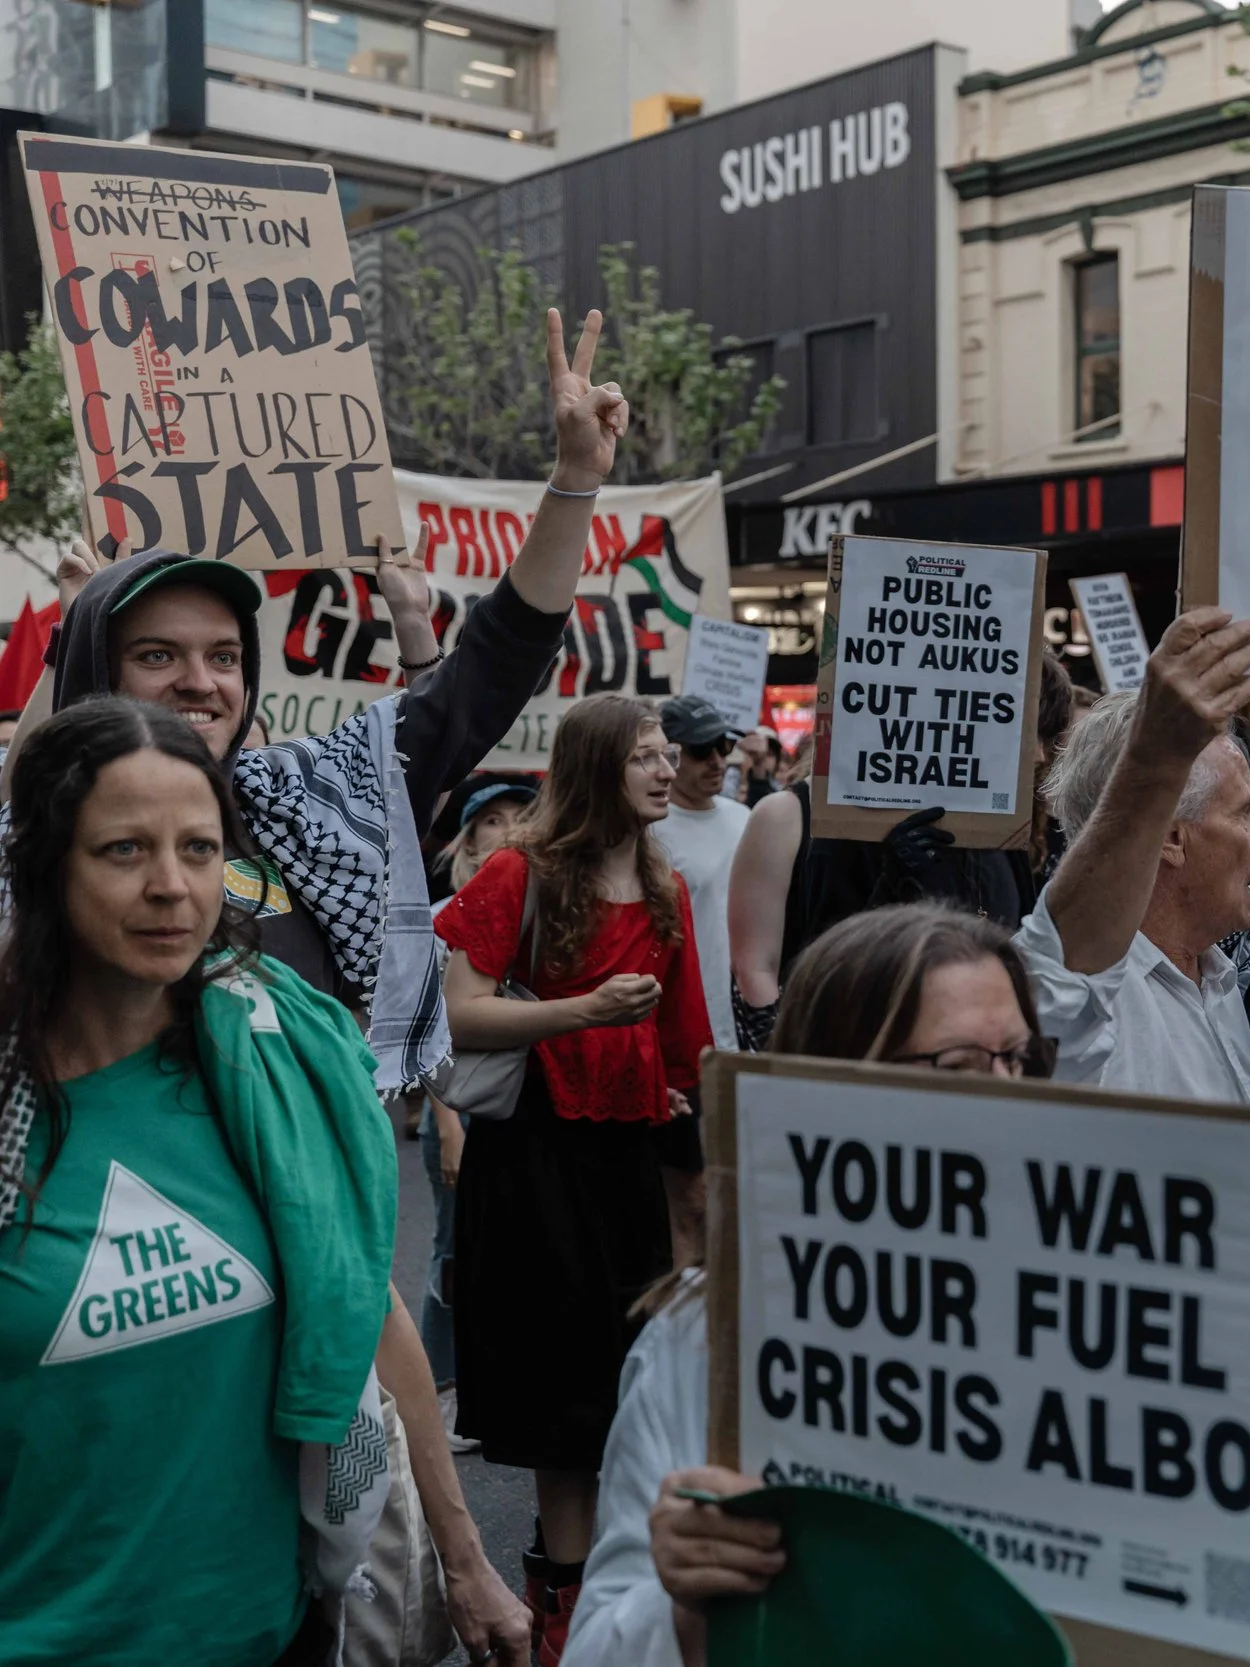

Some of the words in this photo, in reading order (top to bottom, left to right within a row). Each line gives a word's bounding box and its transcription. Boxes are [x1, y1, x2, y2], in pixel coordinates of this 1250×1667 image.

[720, 125, 823, 214] SUSHI
[829, 101, 911, 184] HUB
[50, 201, 312, 248] CONVENTION
[186, 250, 225, 274] OF
[54, 266, 367, 358] COWARDS
[176, 367, 200, 381] IN
[220, 368, 234, 383] A
[81, 390, 377, 460] CAPTURED
[93, 461, 406, 560] STATE
[778, 499, 872, 558] KFC
[917, 566, 957, 576] REDLINE
[918, 556, 967, 567] POLITICAL
[882, 576, 992, 610] PUBLIC
[867, 607, 1002, 643] HOUSING
[844, 637, 905, 667] NOT
[918, 643, 1019, 675] AUKUS
[842, 681, 917, 717] CUT
[934, 688, 1015, 724] TIES
[879, 718, 975, 755] WITH
[857, 750, 989, 789] ISRAEL
[785, 1131, 989, 1240] YOUR
[1023, 1159, 1217, 1271] WAR
[109, 1222, 191, 1277] THE
[78, 1258, 241, 1339] GREENS
[778, 1234, 979, 1349] YOUR
[1014, 1268, 1227, 1393] FUEL
[756, 1337, 1004, 1463] CRISIS
[993, 1534, 1037, 1566] 914
[1041, 1545, 1090, 1579] 977
